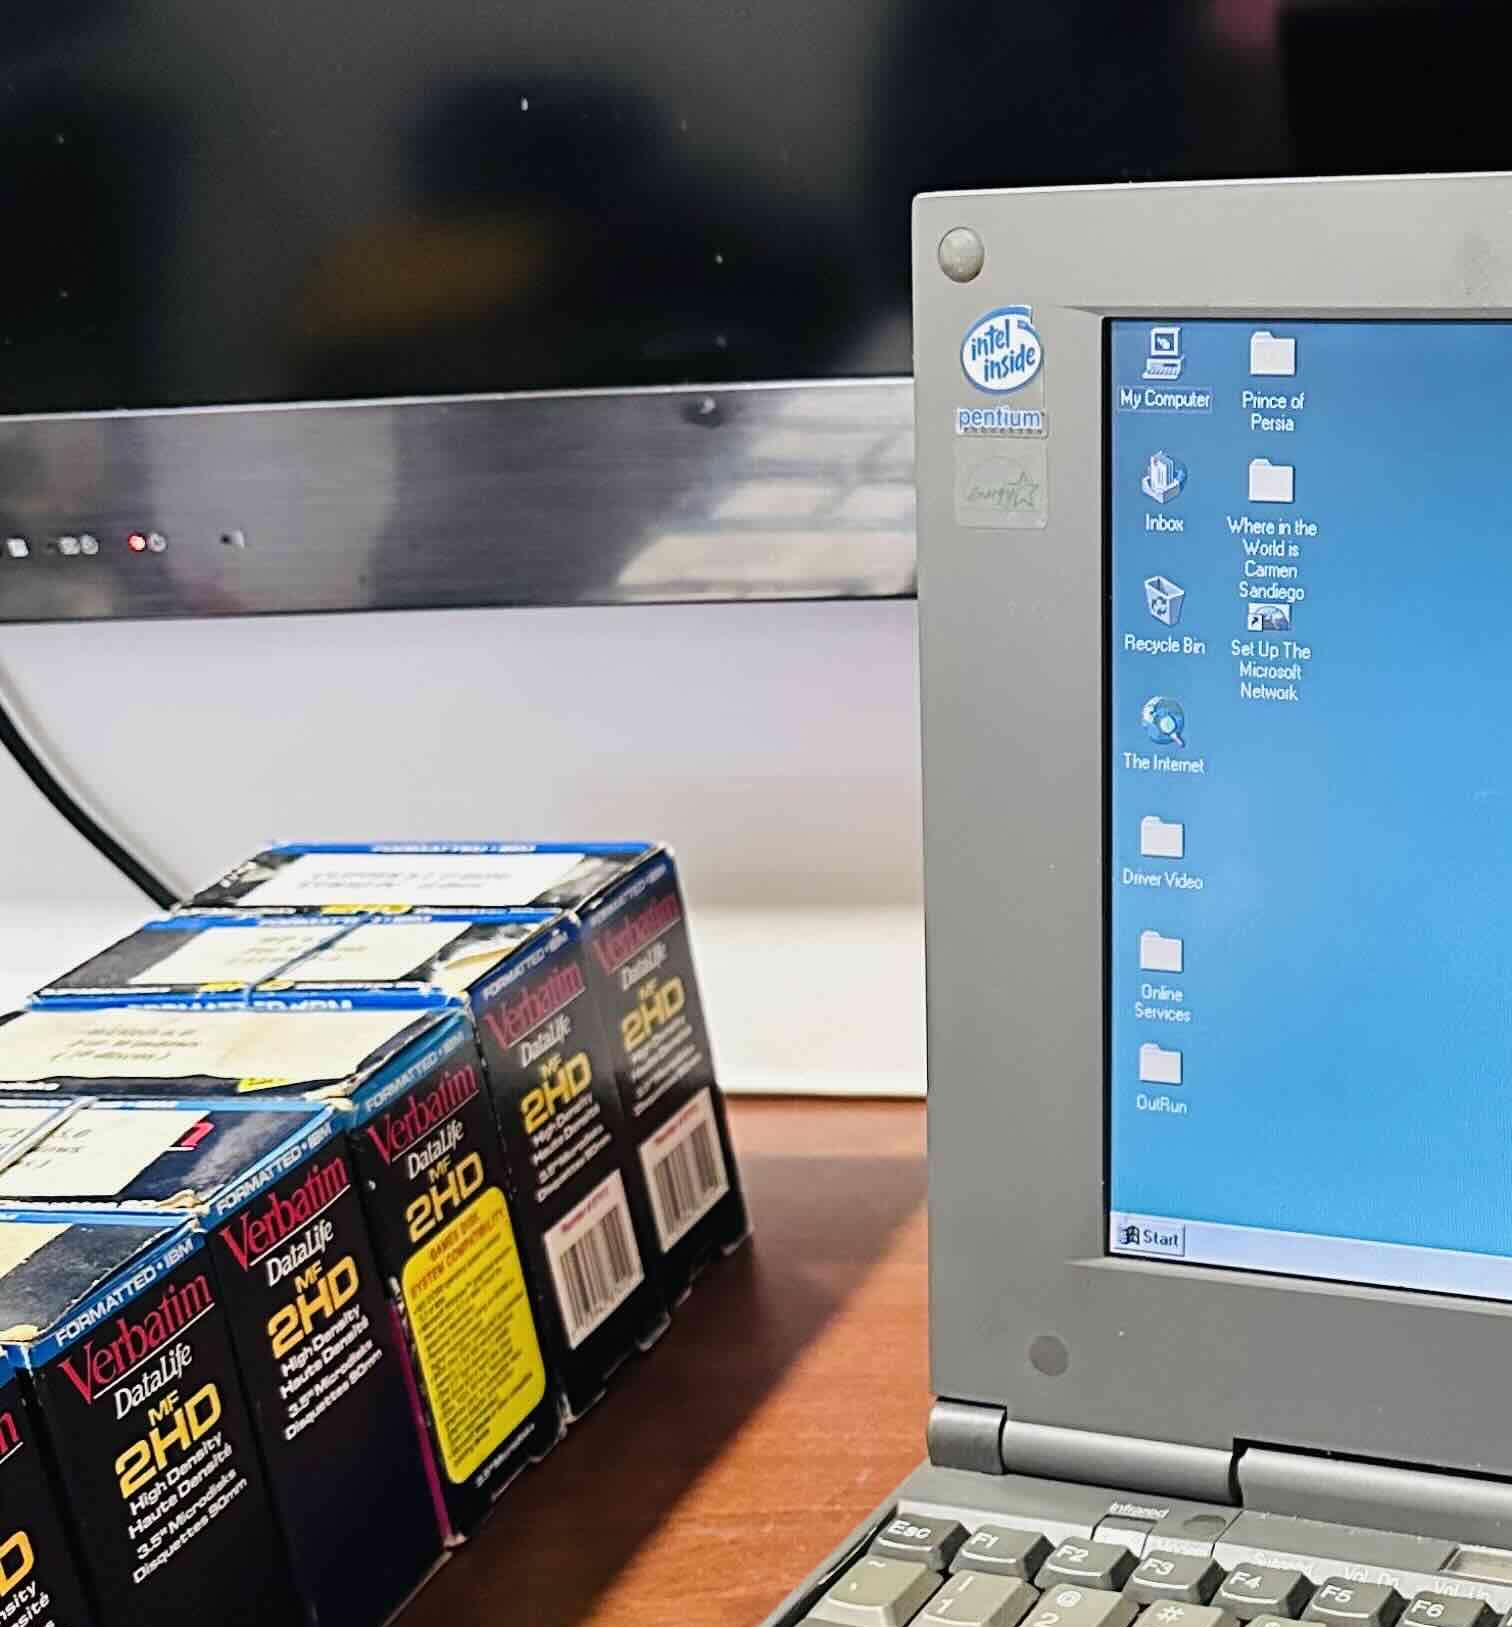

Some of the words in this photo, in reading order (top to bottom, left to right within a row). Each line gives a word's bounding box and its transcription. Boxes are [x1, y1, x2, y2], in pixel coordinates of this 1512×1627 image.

[971, 319, 1010, 361] intel
[984, 344, 1036, 382] inside
[1120, 389, 1141, 409] My
[1144, 389, 1210, 409] Computer
[1242, 392, 1287, 409] Prince
[1290, 392, 1304, 410] of
[959, 408, 1041, 432] pentium
[1250, 414, 1294, 432] Persia
[1145, 513, 1183, 531] Inbox
[1227, 517, 1274, 536] Where
[1277, 518, 1291, 536] in
[1294, 519, 1318, 537] the
[1242, 540, 1284, 557] World
[1287, 541, 1299, 557] is
[1244, 561, 1298, 579] Carmen
[1238, 583, 1305, 603] Sandiego
[1123, 634, 1180, 654] Recycle
[1183, 636, 1206, 655] Bin
[1231, 640, 1255, 658] Set
[1258, 642, 1279, 662] Up
[1282, 643, 1312, 661] The
[1239, 662, 1302, 681] Microsoft
[1240, 682, 1299, 702] Network
[1123, 752, 1150, 770] The
[1152, 753, 1205, 775] Internet
[1122, 868, 1164, 887] Driver
[1166, 871, 1204, 890] Video
[484, 962, 586, 1050] Verbatim
[1141, 984, 1183, 1002] Online
[622, 976, 686, 1051] 2HD
[1135, 1003, 1192, 1024] Services
[365, 1052, 439, 1113] FORMATTED
[520, 1052, 593, 1136] 2HD
[367, 1063, 479, 1167] Verbatim
[1136, 1095, 1188, 1114] OutRun
[408, 1119, 466, 1181] DataLife
[216, 1149, 302, 1216] FORMATTED
[308, 1122, 333, 1149] IBM
[218, 1156, 349, 1272] Verbatim
[405, 1151, 484, 1243] 2HD
[265, 1218, 335, 1287] DataLife
[1143, 1229, 1179, 1249] Start
[54, 1265, 158, 1349] FORMATTED
[164, 1237, 194, 1270] IBM
[293, 1260, 325, 1294] MF
[267, 1255, 361, 1359] 2HD
[57, 1273, 213, 1406] Verbatim
[279, 1358, 324, 1400] Haute
[322, 1312, 370, 1364] Densité
[280, 1343, 311, 1378] High
[311, 1303, 361, 1349] Density
[114, 1341, 193, 1420] DataLife
[314, 1338, 374, 1398] Microdisks
[147, 1389, 180, 1427] MF
[284, 1376, 351, 1441] Disquettes
[350, 1348, 384, 1386] 90mm
[114, 1382, 223, 1499] 2HD
[127, 1492, 179, 1541] Haute
[177, 1442, 233, 1500] Densité
[129, 1478, 168, 1517] High
[166, 1430, 224, 1485] Density
[166, 1466, 237, 1537] Microdisks
[132, 1514, 209, 1585] Disquettes
[207, 1475, 249, 1520] 90mm
[886, 1520, 933, 1539] Esc
[969, 1530, 999, 1549] F1
[1056, 1545, 1089, 1564] F2
[1142, 1557, 1175, 1577] F3
[1229, 1570, 1262, 1590] F4
[1318, 1584, 1353, 1603] F5
[0, 1580, 37, 1622] nsity
[1410, 1599, 1444, 1617] F6
